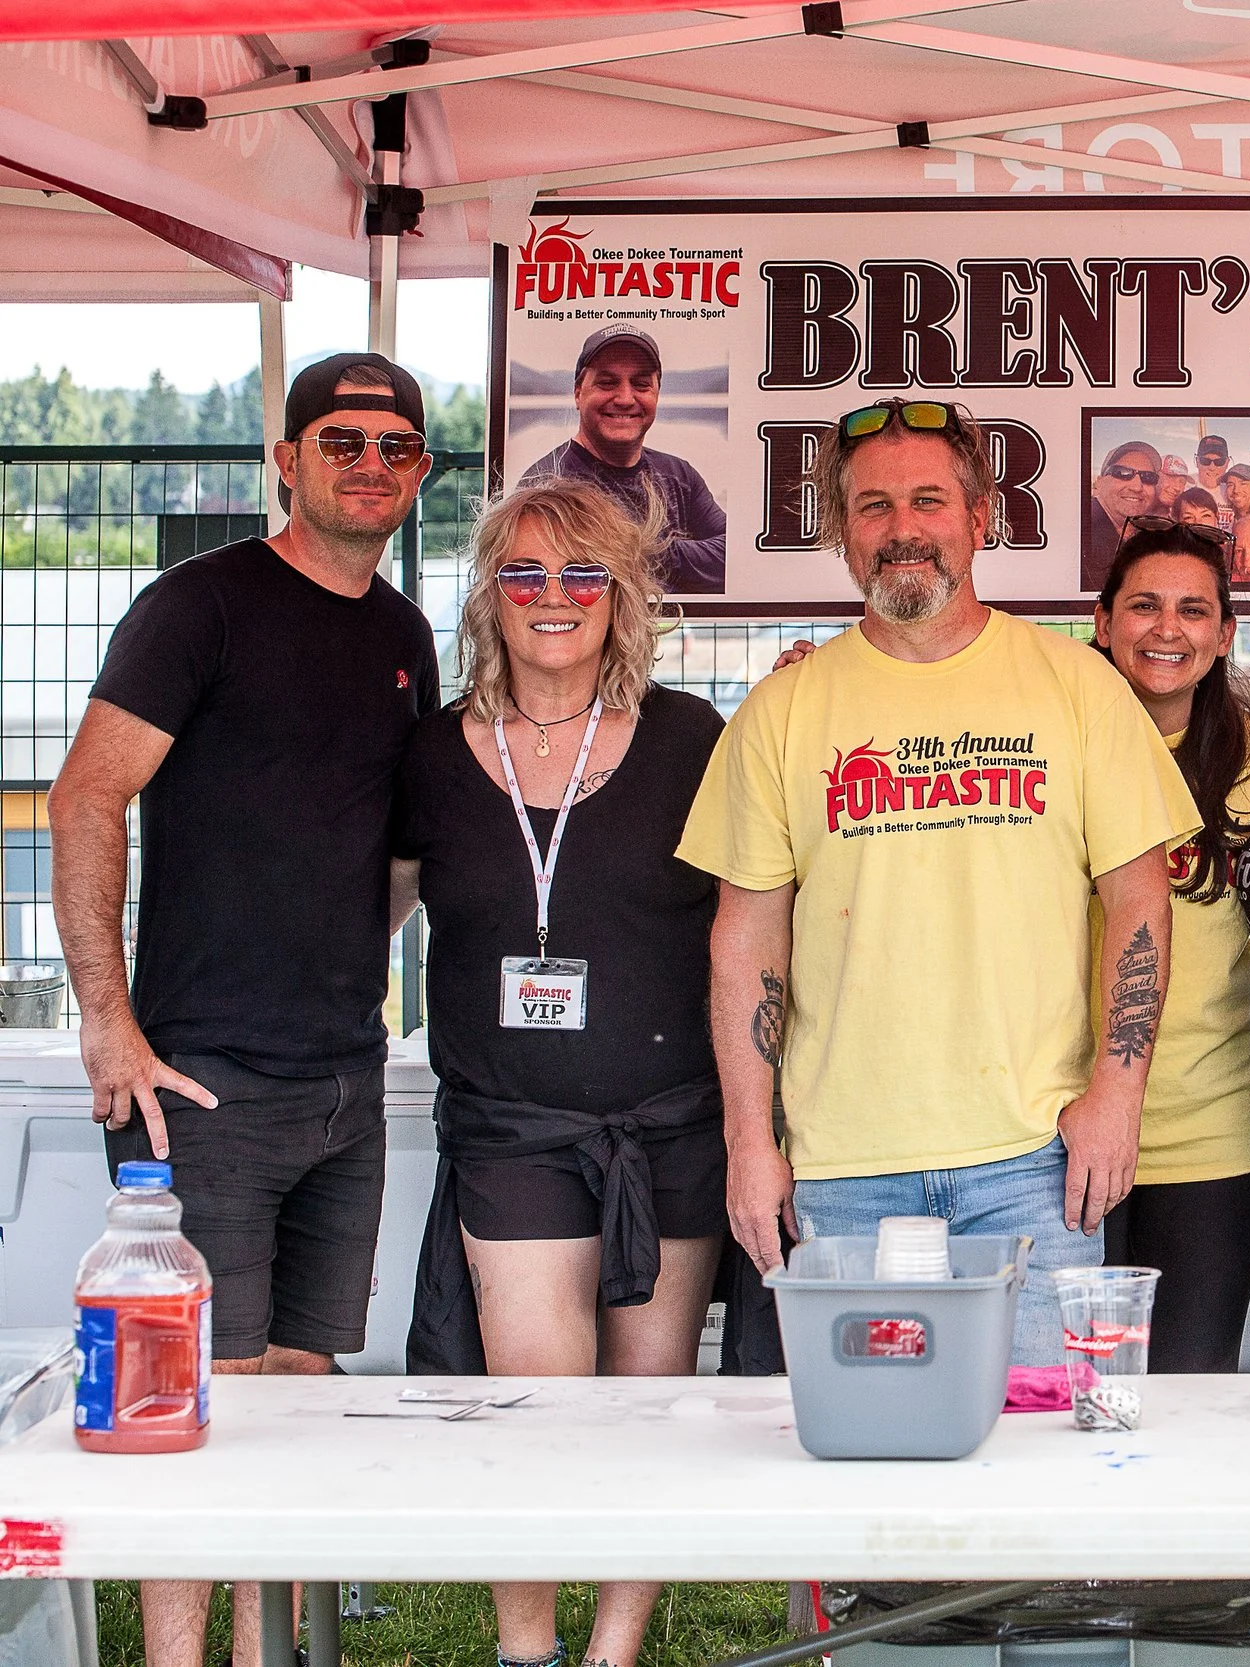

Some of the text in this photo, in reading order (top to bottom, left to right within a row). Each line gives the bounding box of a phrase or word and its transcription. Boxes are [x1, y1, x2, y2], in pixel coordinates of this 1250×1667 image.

[592, 247, 743, 260] Okee Dokee Tournament
[514, 261, 740, 311] FUNTASTIC
[527, 309, 564, 321] Building
[575, 309, 604, 319] Better
[606, 309, 657, 321] Community
[660, 308, 698, 321] Through
[700, 308, 726, 321] Sport
[756, 418, 1048, 552] BR
[897, 731, 1034, 760] 34th Annual
[898, 755, 1048, 775] Okee Dokee Tournament
[826, 768, 1046, 833] FUNTASTIC
[842, 814, 1033, 839] Building a Better Community Through Sport
[1120, 953, 1155, 971] Laura
[519, 987, 571, 1001] FUNTASTIC
[1116, 976, 1152, 996] David
[521, 1003, 566, 1019] VIP
